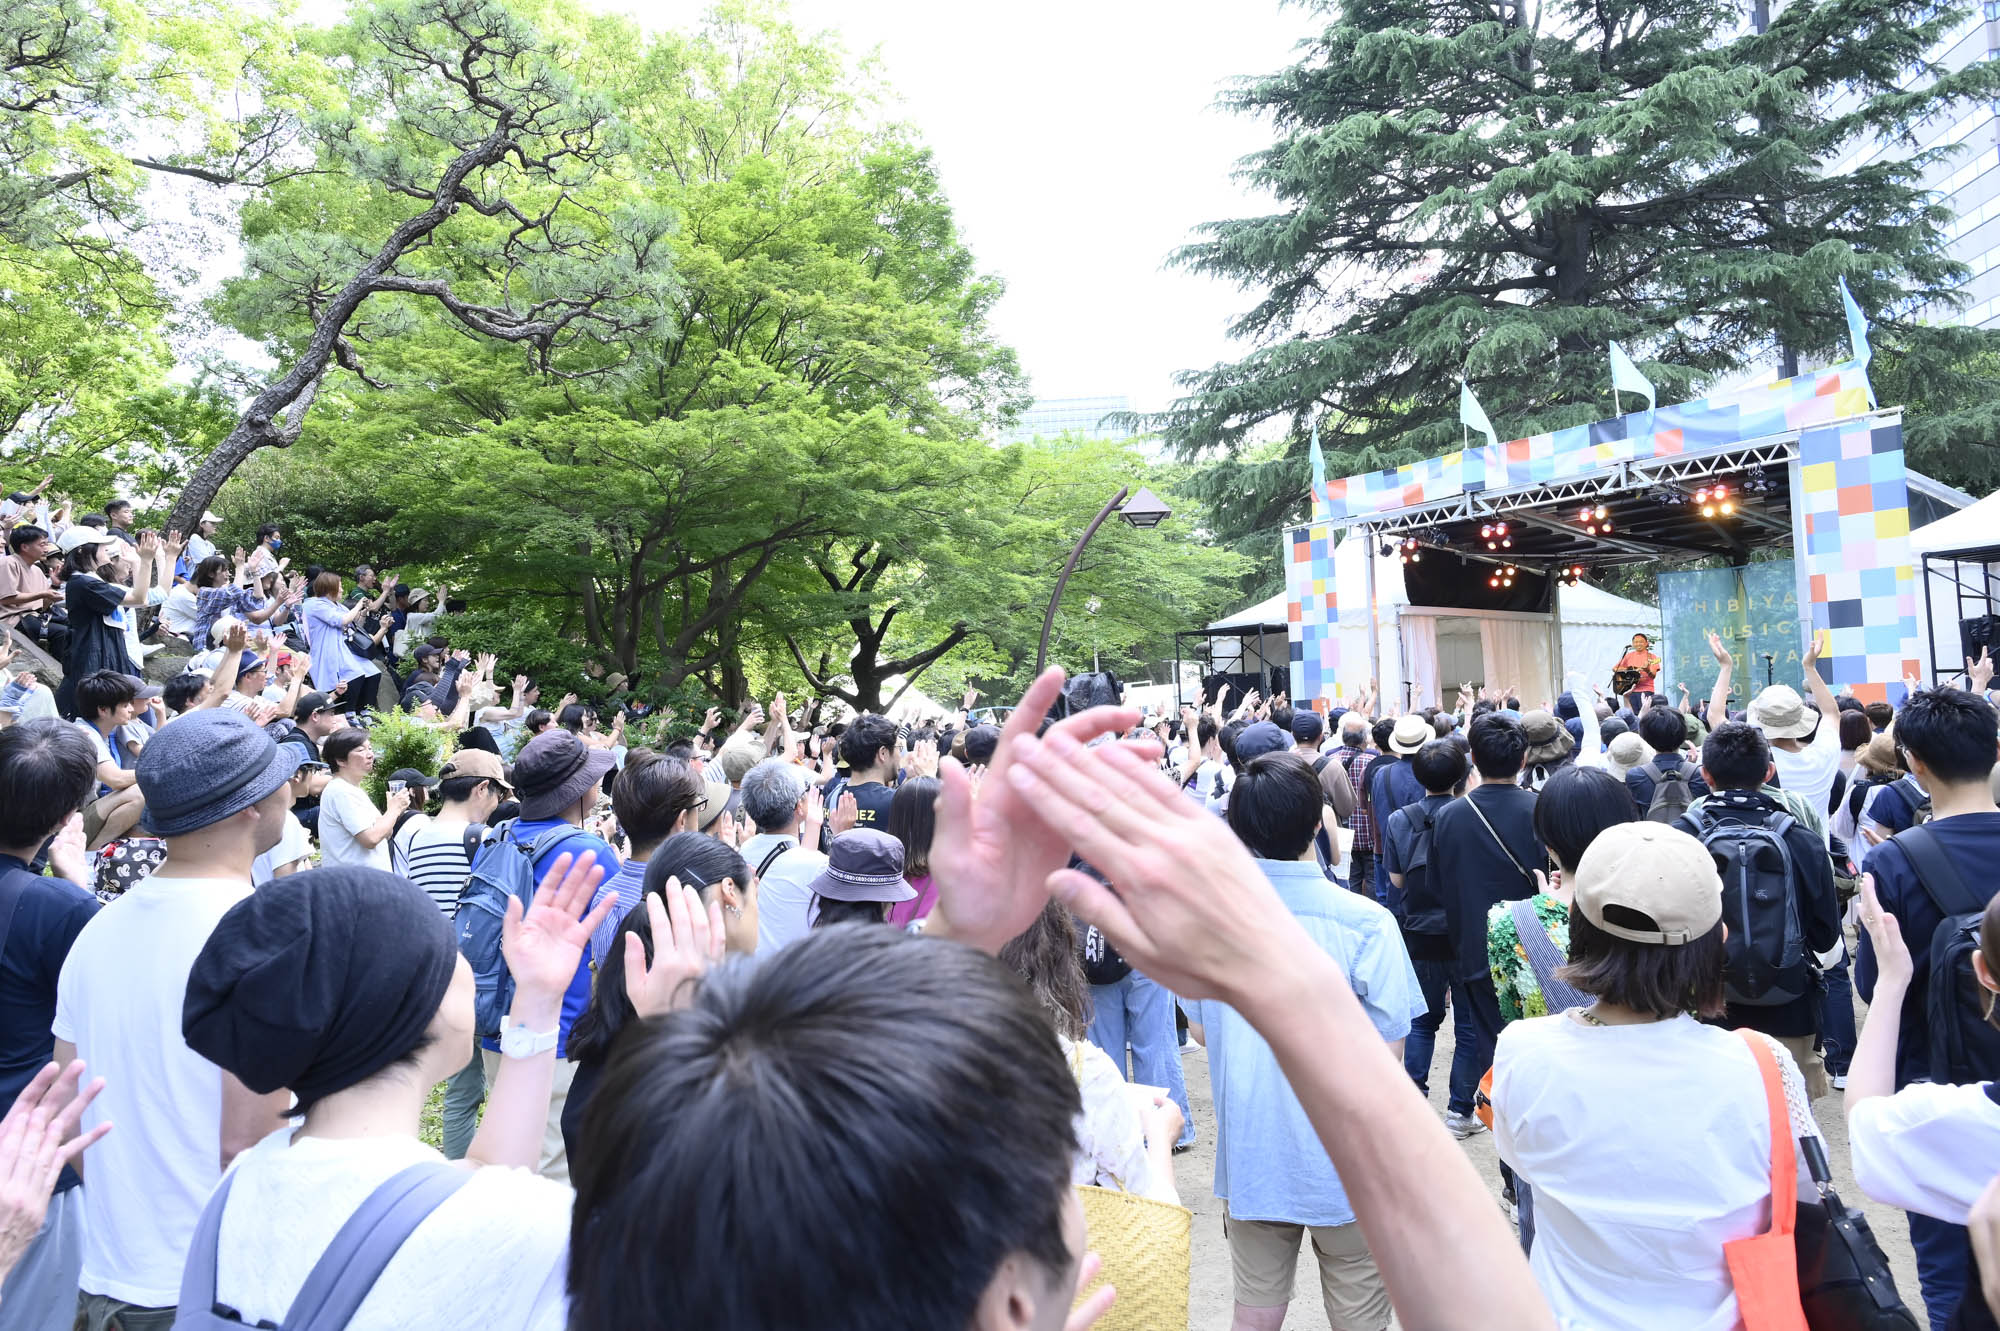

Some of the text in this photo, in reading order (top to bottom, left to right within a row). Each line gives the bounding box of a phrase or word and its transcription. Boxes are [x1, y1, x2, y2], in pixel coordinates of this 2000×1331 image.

[1695, 591, 1796, 613] HIBIYA
[1703, 620, 1792, 640] MUSIC
[1681, 649, 1799, 669] FETIVA
